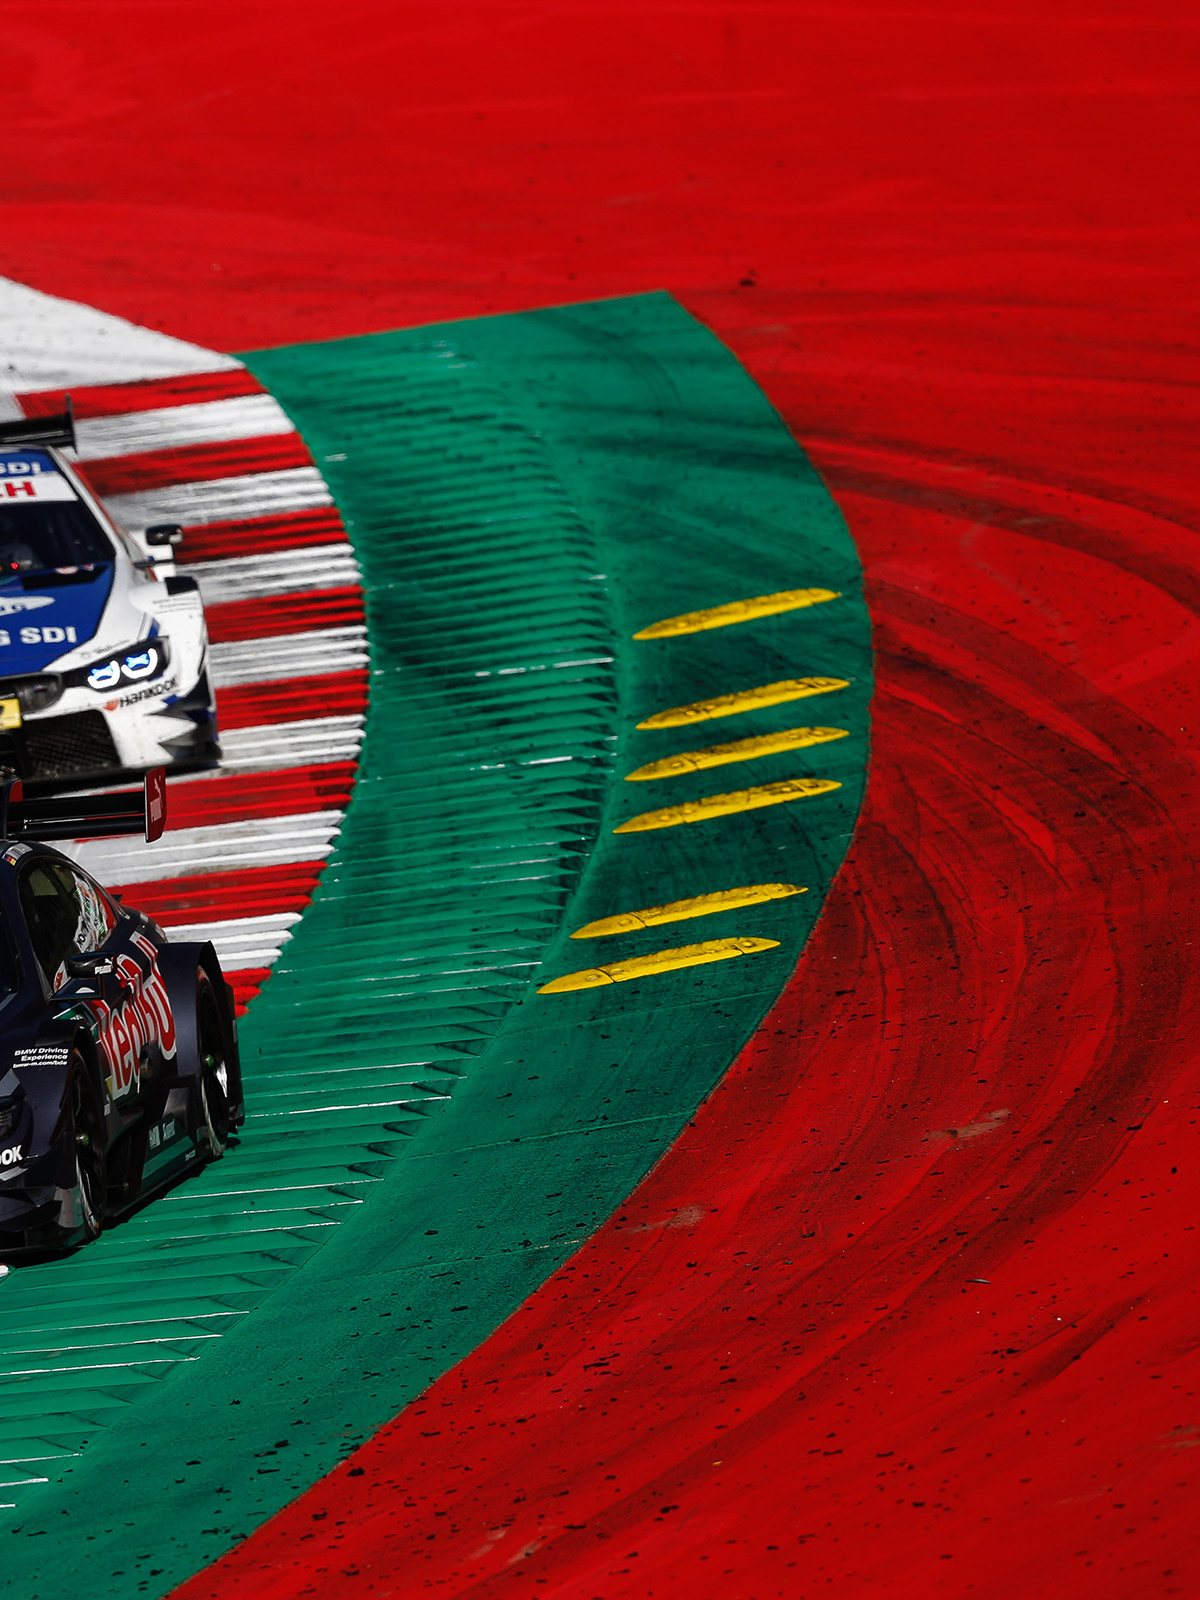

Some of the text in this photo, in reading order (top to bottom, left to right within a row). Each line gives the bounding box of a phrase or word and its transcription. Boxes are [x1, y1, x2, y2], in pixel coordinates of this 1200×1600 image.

[19, 626, 78, 645] SDI
[14, 1048, 38, 1056] BMW
[21, 1054, 68, 1062] Experience
